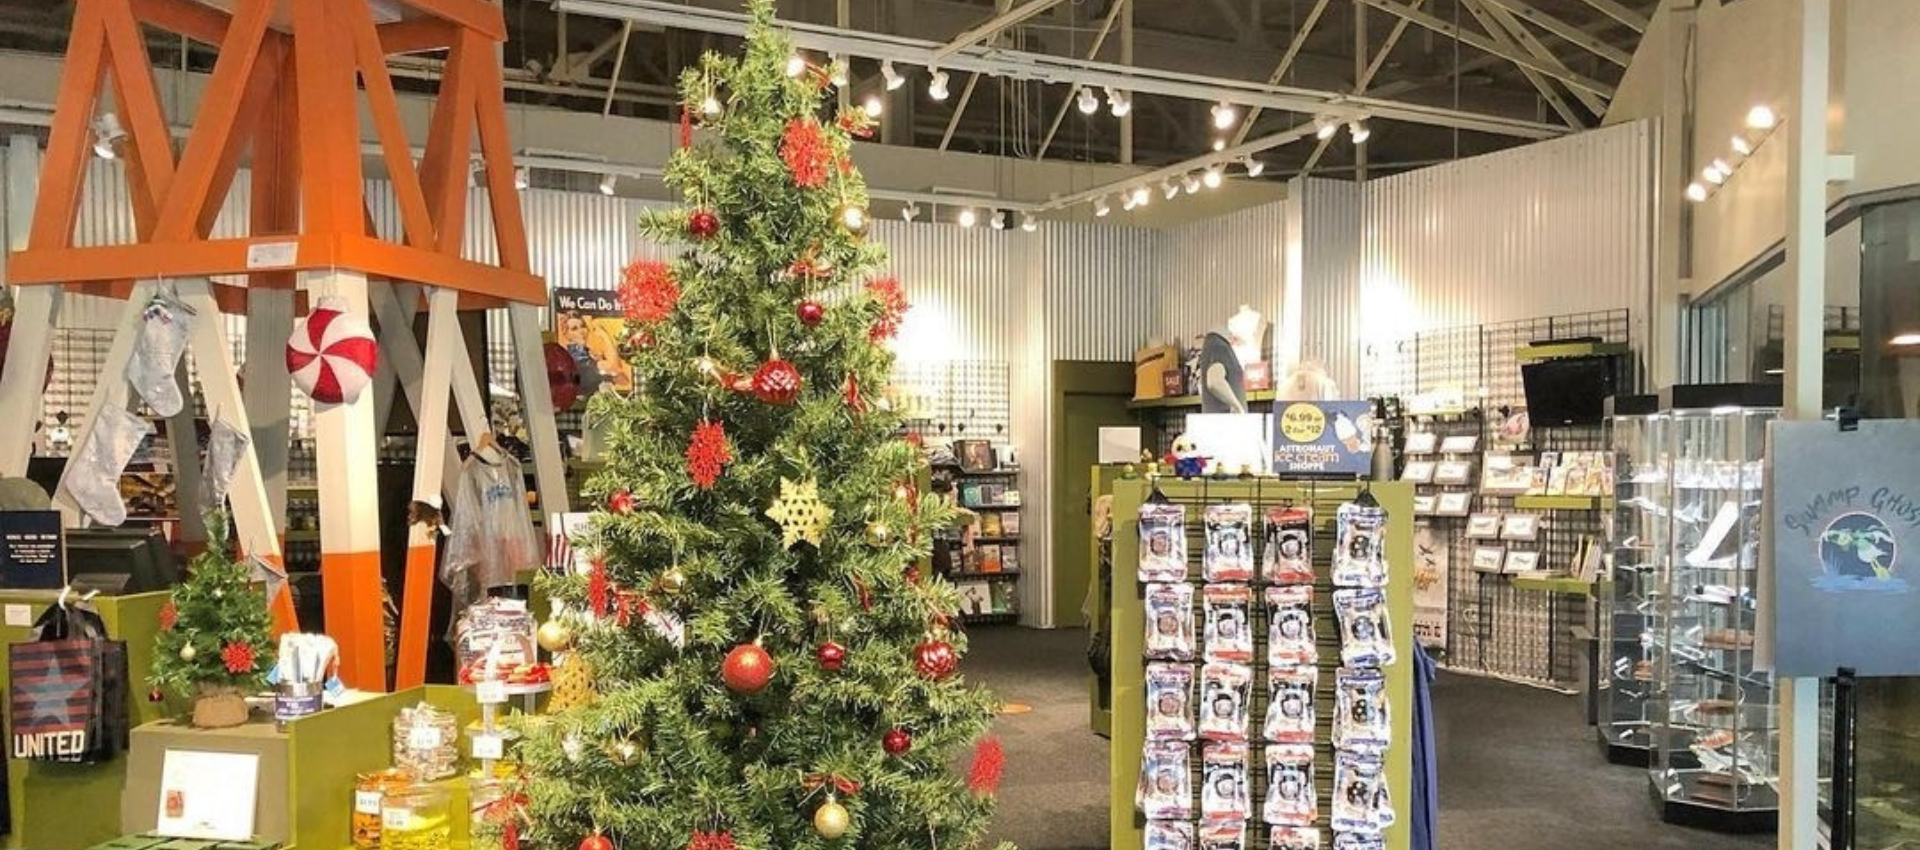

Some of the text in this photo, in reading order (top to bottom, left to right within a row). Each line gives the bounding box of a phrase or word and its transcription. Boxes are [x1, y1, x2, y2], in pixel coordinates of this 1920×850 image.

[559, 295, 576, 309] We
[577, 297, 597, 309] Can
[598, 297, 612, 310] Do
[1285, 425, 1291, 434] 2
[1306, 425, 1321, 434] $12
[1279, 444, 1336, 453] ASTRONAUT
[1295, 451, 1340, 463] cream
[1289, 462, 1325, 471] SHOPPE
[14, 730, 85, 758] UNITED
